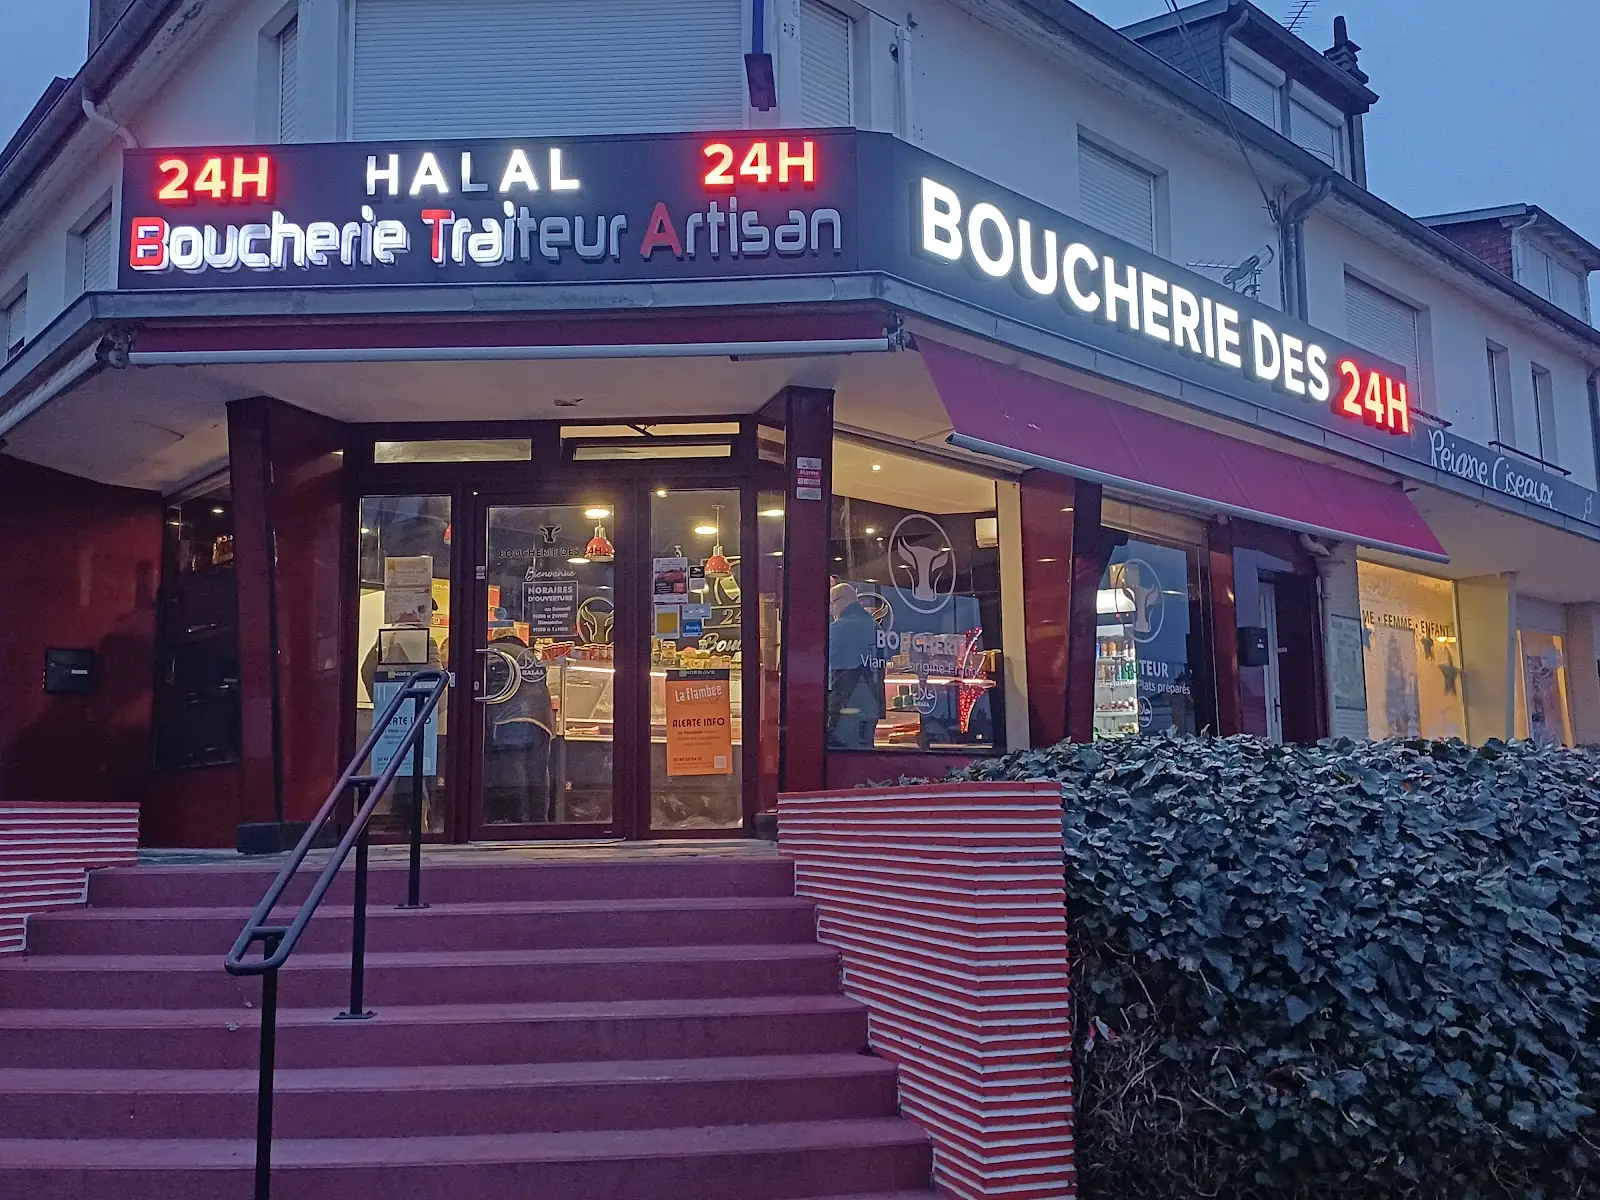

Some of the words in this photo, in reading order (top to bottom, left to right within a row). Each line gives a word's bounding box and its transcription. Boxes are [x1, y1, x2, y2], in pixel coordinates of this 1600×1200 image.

[158, 156, 270, 200] 24H
[366, 147, 581, 196] HALAL
[703, 140, 816, 186] 24H
[130, 204, 408, 273] Boucherie
[421, 200, 627, 264] Traiteur
[640, 196, 842, 258] Artisan
[921, 176, 1242, 369] BOUCHERIE
[1252, 319, 1331, 403] DES
[1338, 359, 1411, 434] 24H
[1492, 457, 1558, 511] Ciseaux
[525, 565, 577, 581] Bienvenue
[528, 586, 573, 595] HORAIRES
[1383, 613, 1412, 629] FEMME
[1420, 620, 1450, 636] ENFANT
[674, 689, 685, 702] La
[1157, 683, 1191, 695] préparés
[672, 718, 701, 728] ALERTE
[703, 717, 725, 727] INFO
